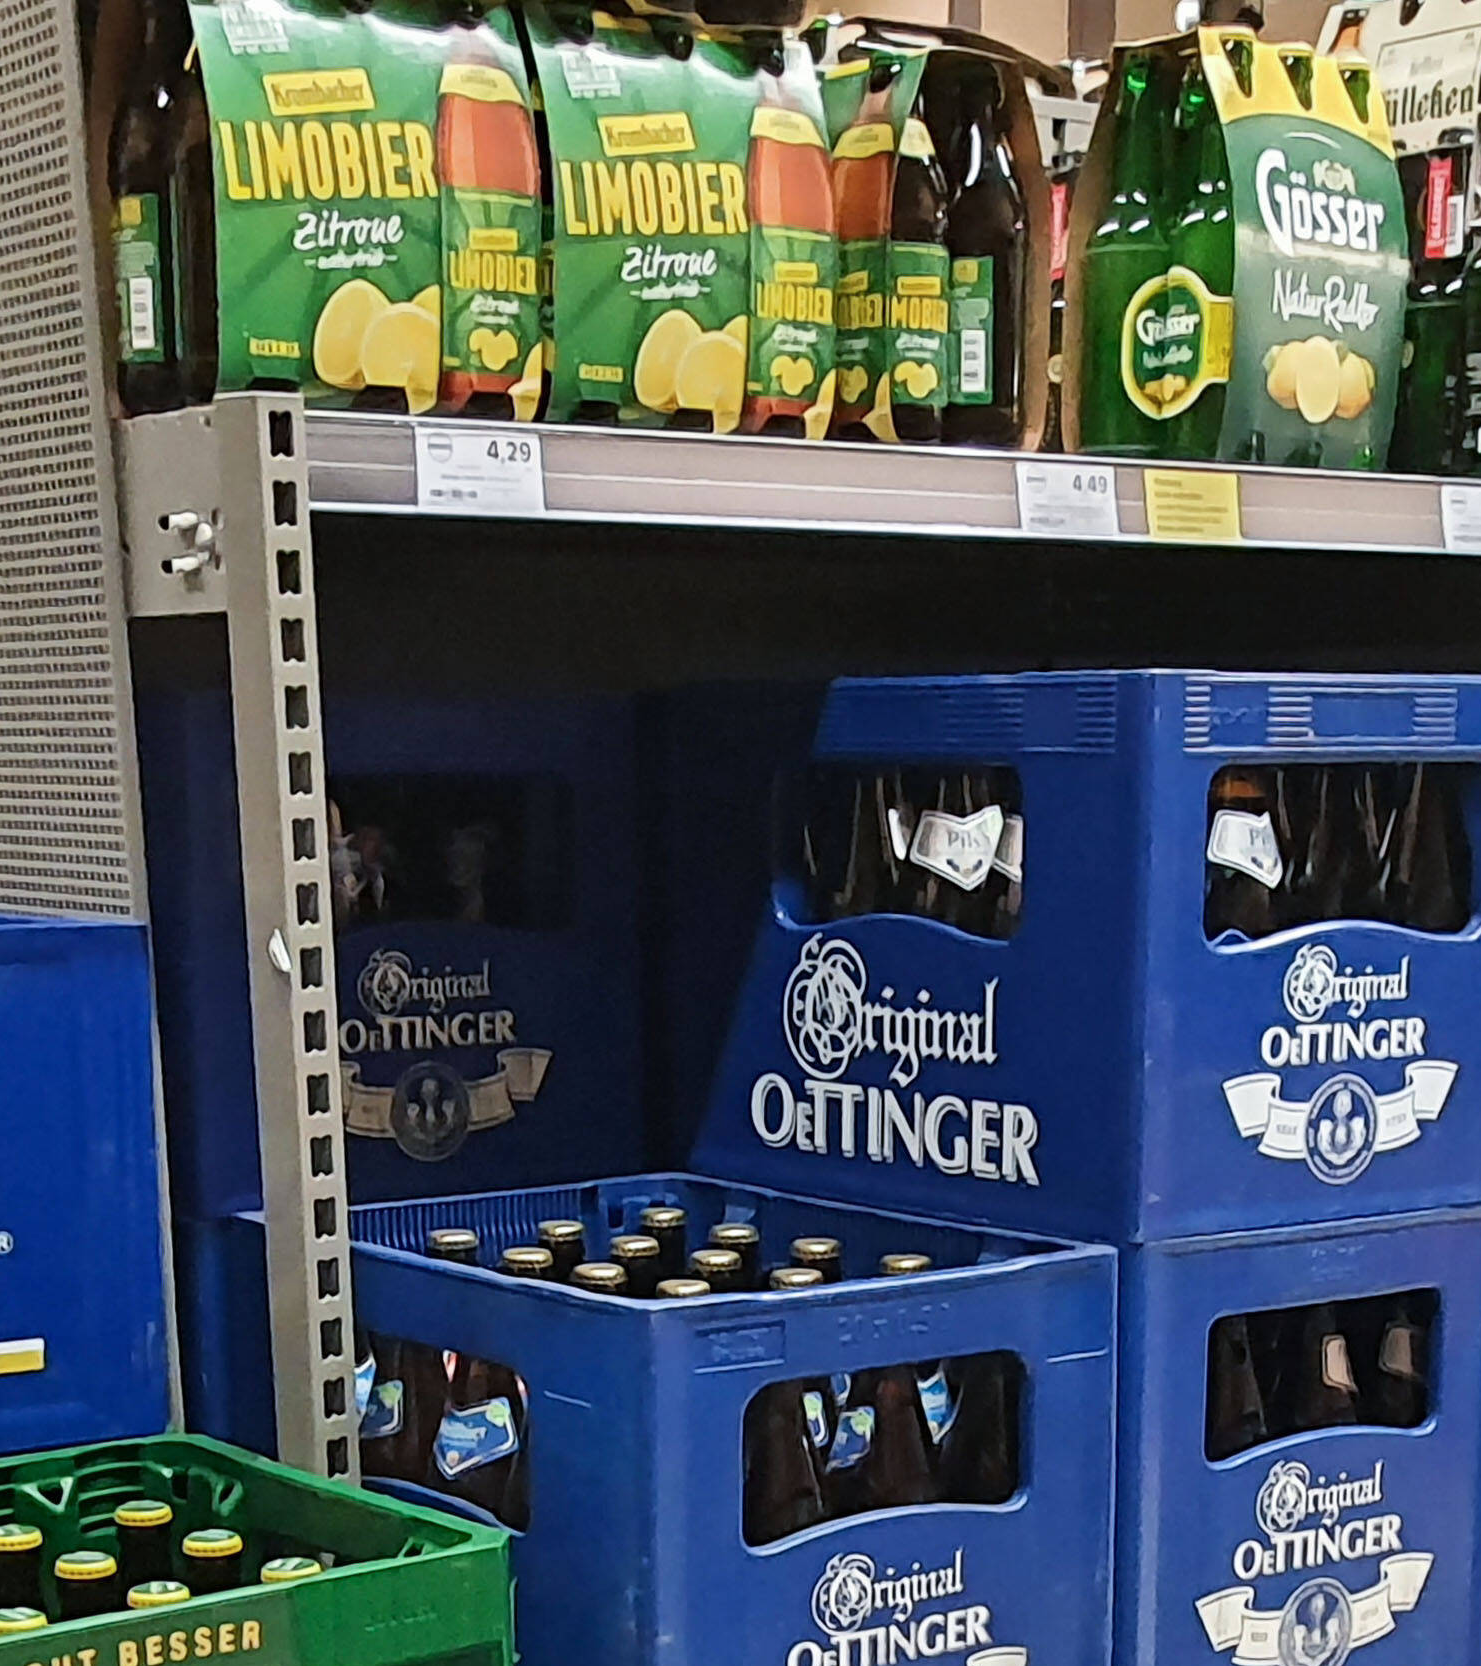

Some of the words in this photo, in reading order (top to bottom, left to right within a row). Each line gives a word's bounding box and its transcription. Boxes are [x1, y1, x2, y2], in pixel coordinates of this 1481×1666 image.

[1386, 80, 1473, 127] ülleken
[220, 120, 438, 200] LIMOBIER
[293, 209, 404, 251] Zitrone
[559, 161, 747, 236] LIMOBIER
[1256, 148, 1385, 257] Gösser
[621, 246, 717, 284] Zitrone
[486, 439, 531, 464] 4,29
[356, 947, 491, 1018] Original
[783, 932, 1000, 1086] Original
[1282, 943, 1411, 1023] Original
[1256, 1458, 1383, 1536] Original
[811, 1546, 964, 1639] Original
